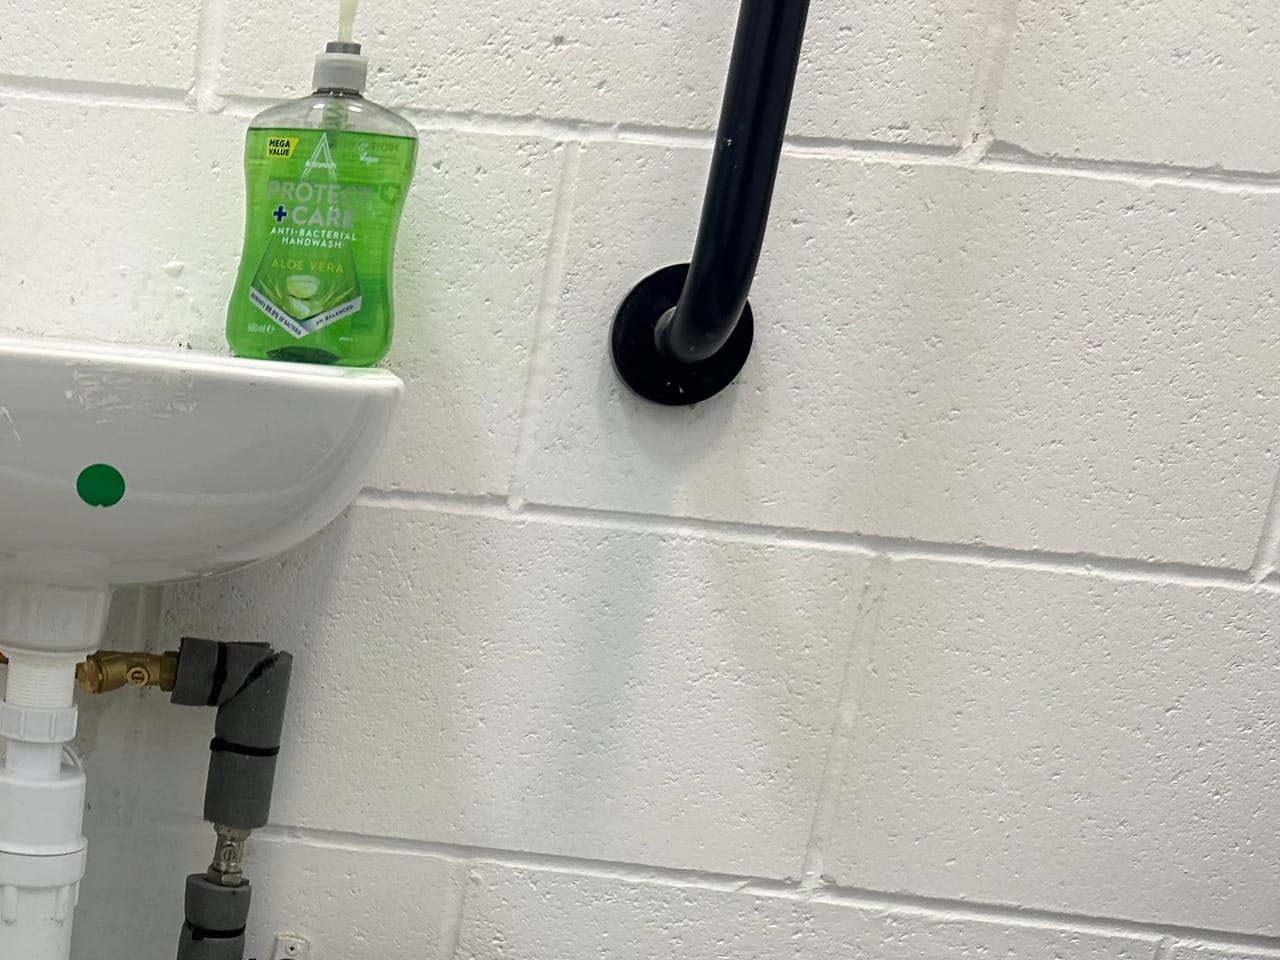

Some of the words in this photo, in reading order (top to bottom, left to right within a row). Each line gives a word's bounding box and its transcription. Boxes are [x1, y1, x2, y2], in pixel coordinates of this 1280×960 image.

[269, 139, 291, 148] MEGA
[269, 148, 290, 156] VALUE
[270, 226, 356, 241] ANTI-BACTERIAL
[282, 236, 342, 249] HANDWASH
[272, 259, 304, 271] ALOE
[310, 261, 344, 273] VERA
